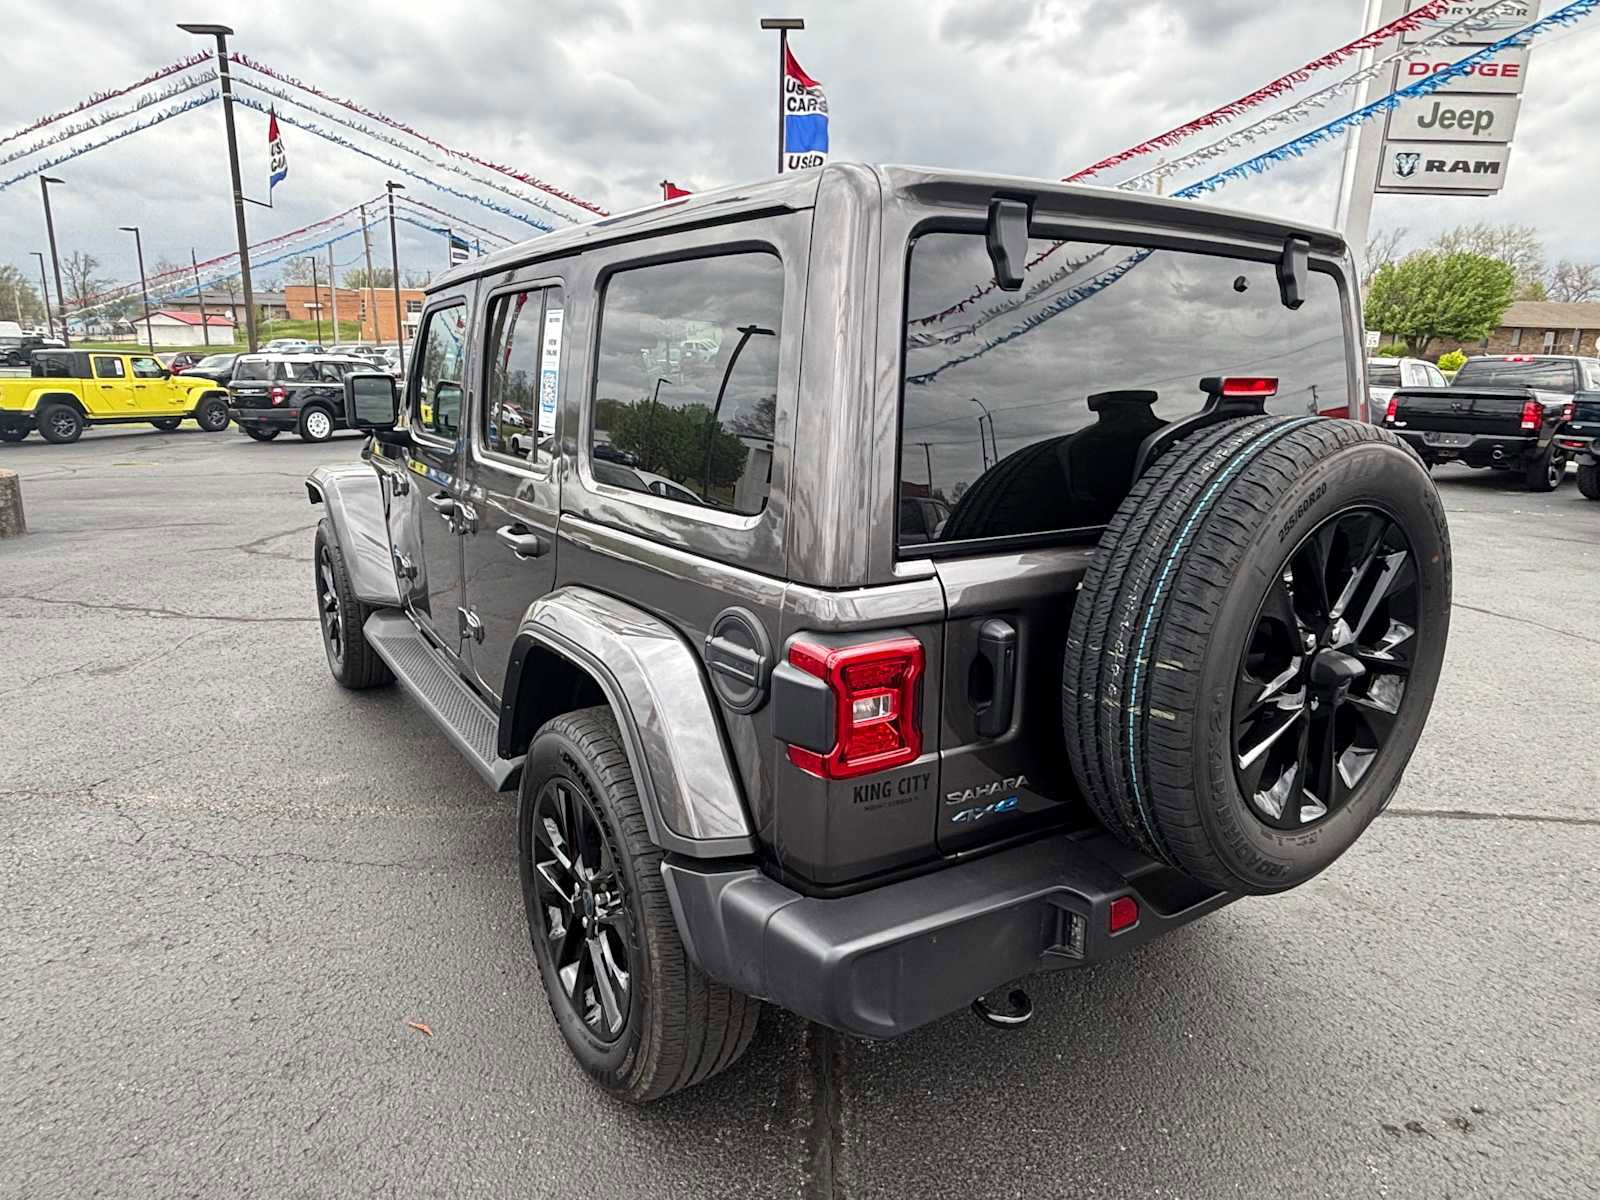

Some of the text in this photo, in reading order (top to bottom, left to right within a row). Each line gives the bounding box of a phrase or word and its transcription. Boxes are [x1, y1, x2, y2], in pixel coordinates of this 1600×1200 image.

[787, 96, 828, 113] CARS
[1417, 101, 1495, 136] Jeep
[1424, 159, 1500, 174] RAM
[1278, 482, 1327, 543] 255/60R20
[853, 772, 931, 804] KING CITY
[945, 774, 1030, 805] SAHARA
